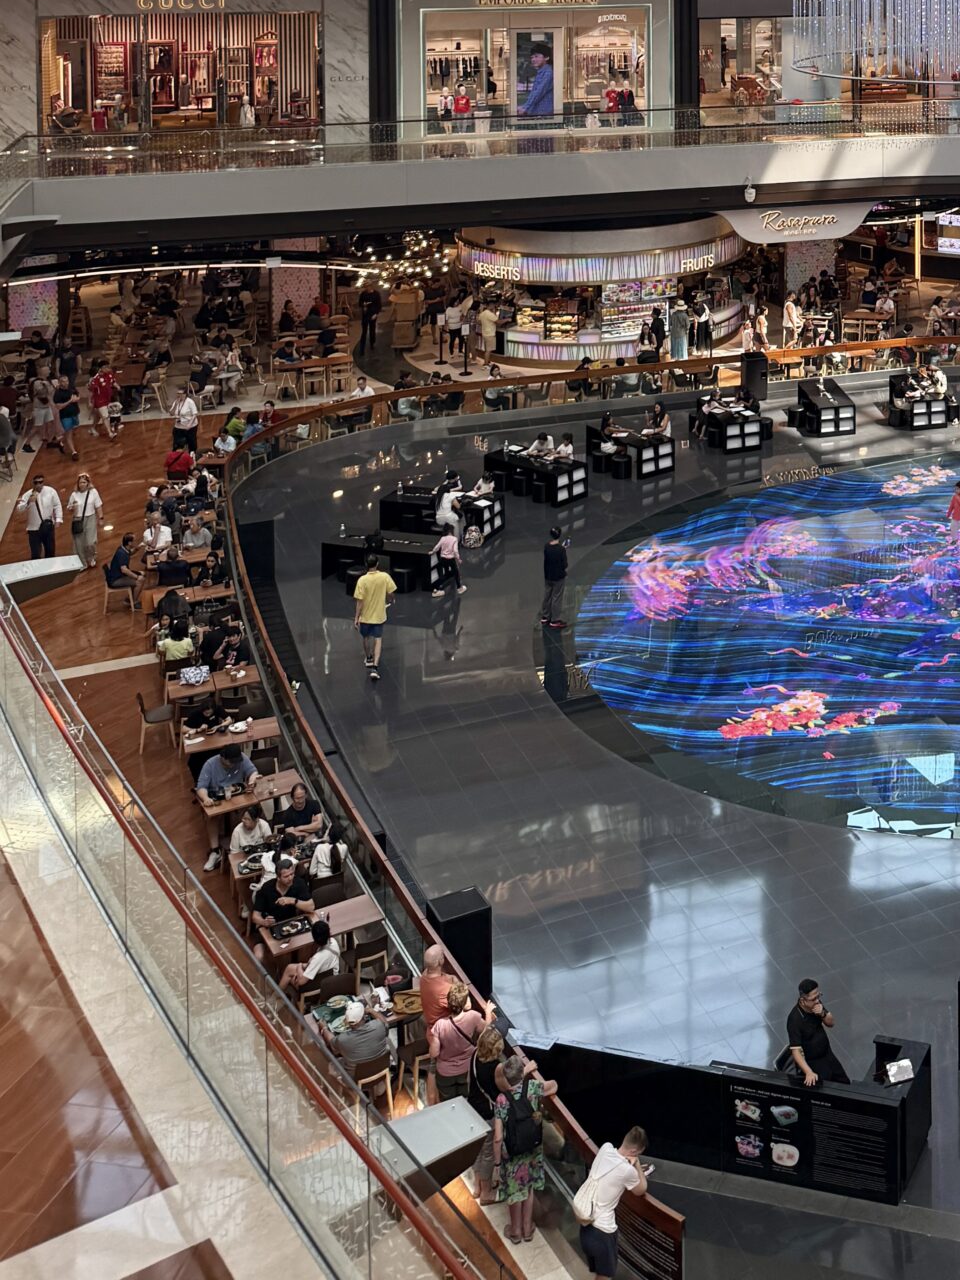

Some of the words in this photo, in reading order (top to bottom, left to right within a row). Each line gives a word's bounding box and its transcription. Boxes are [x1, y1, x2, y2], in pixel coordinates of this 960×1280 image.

[760, 210, 838, 231] Rasapura
[474, 261, 521, 281] DESSERTS
[680, 254, 715, 273] FRUITS
